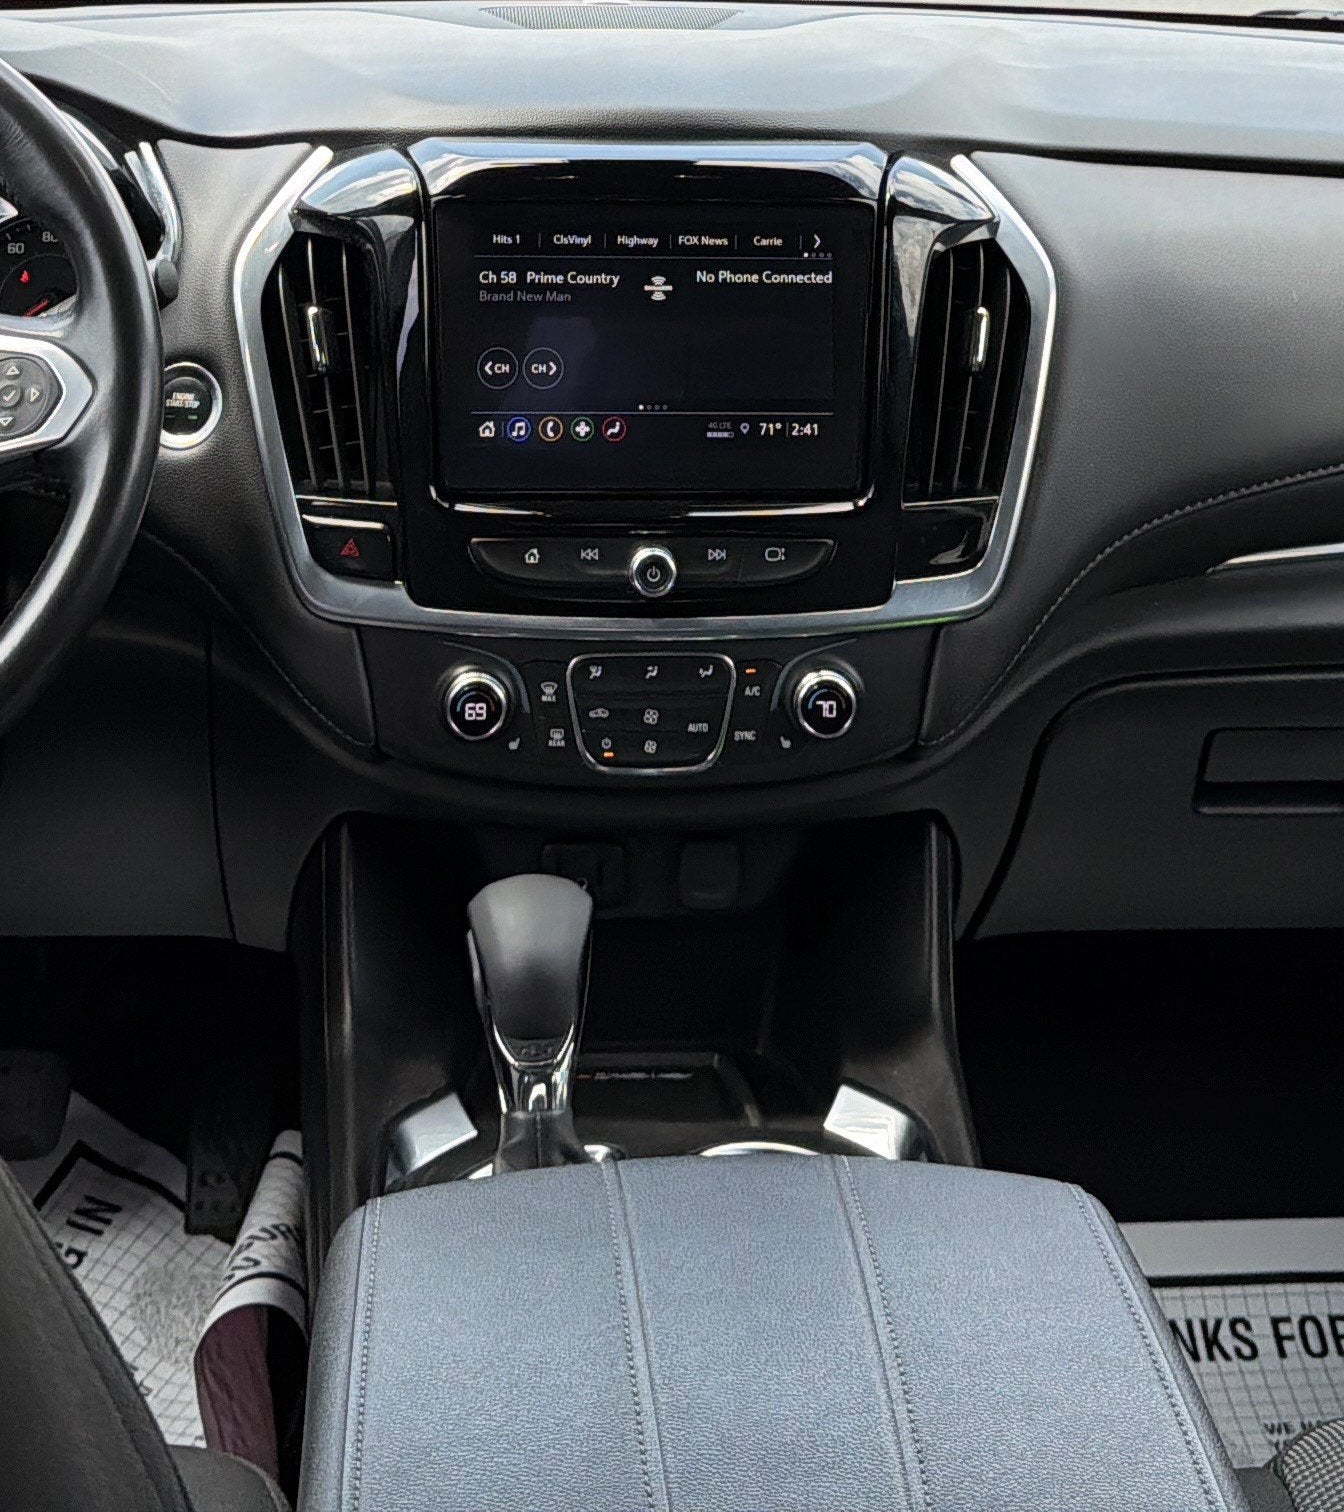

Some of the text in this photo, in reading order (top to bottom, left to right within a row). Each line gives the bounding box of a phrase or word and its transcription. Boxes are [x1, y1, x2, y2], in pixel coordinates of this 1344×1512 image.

[492, 233, 514, 246] Hits
[552, 234, 592, 248] ClsVinyl
[617, 235, 659, 248] Highway
[678, 235, 729, 246] FOX News
[753, 235, 783, 247] Carrie
[7, 242, 25, 254] 60
[478, 270, 621, 288] Ch 58 Prime Country
[696, 270, 833, 285] No Phone Connected
[478, 290, 572, 303] Brand New Man
[494, 363, 510, 374] CH
[531, 363, 547, 374] CH
[791, 422, 819, 436] 2:41
[744, 685, 761, 697] A/C
[464, 701, 488, 722] 69
[815, 699, 838, 720] 70
[687, 722, 709, 733] AUTO
[734, 730, 757, 742] SYNC
